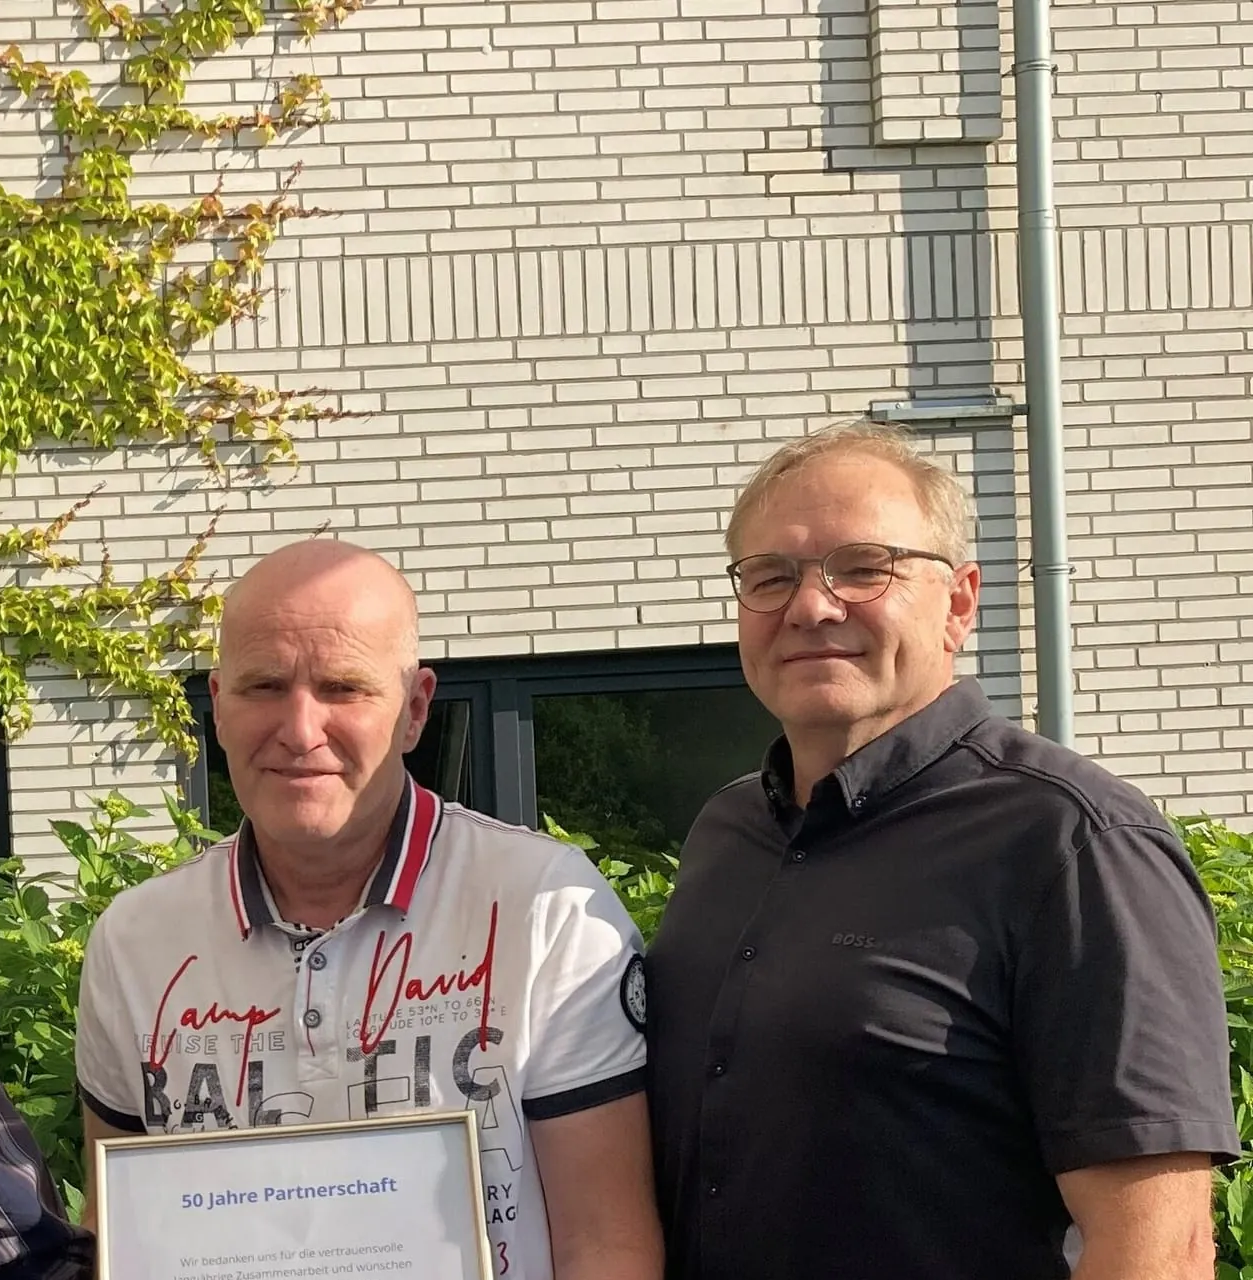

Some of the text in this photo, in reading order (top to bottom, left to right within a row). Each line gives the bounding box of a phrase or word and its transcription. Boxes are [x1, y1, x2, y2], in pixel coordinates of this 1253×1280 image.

[832, 933, 877, 949] BOSS
[150, 955, 281, 1107] Camp
[360, 901, 498, 1055] David
[444, 1000, 461, 1011] TO
[452, 1010, 468, 1022] TO
[231, 1031, 285, 1054] THE
[181, 1177, 398, 1210] 50 Jahre Partnerschaft
[179, 1242, 404, 1268] Wir bedanken uns für die vertrauensvolle
[236, 1264, 330, 1280] Zusammenarbeit
[331, 1262, 354, 1274] und
[356, 1259, 413, 1273] wünschen
